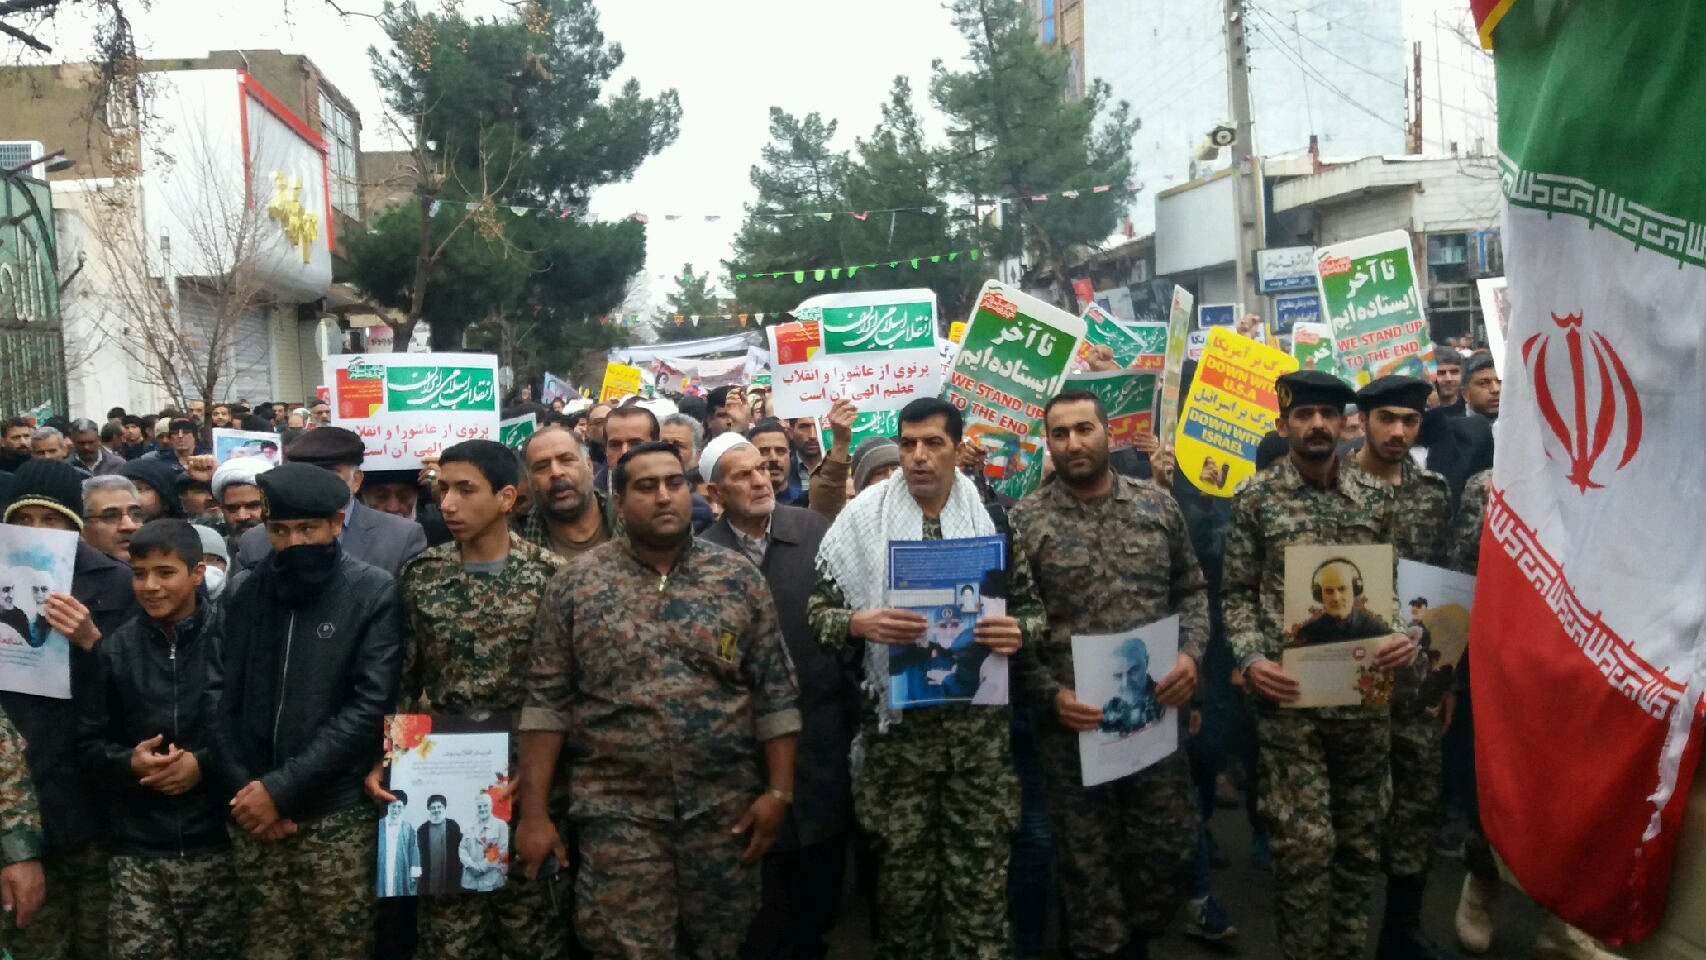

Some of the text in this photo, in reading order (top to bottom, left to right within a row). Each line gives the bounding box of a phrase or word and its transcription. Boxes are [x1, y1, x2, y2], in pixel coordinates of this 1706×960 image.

[1346, 259, 1377, 299] آخر
[1381, 259, 1395, 280] تا
[990, 321, 1043, 348] آخر
[1037, 332, 1057, 357] تا
[1337, 337, 1359, 352] WE
[1361, 326, 1402, 346] STAND
[1405, 321, 1423, 334] UP
[1213, 335, 1252, 360] آمریکا
[1346, 355, 1364, 368] TO
[1367, 348, 1391, 364] THE
[783, 369, 819, 386] انقلاب
[824, 372, 830, 384] و
[834, 365, 874, 382] عاشورا
[878, 363, 890, 380] از
[894, 362, 929, 379] پرتوی
[1206, 356, 1249, 383] DOWN
[1249, 374, 1278, 396] WIT
[800, 382, 914, 402] عظیم الهی آن است
[951, 371, 1045, 420] WE STAND UP
[949, 392, 1028, 435] TO THE END
[353, 425, 381, 438] انقلا
[385, 429, 392, 440] و
[395, 424, 437, 440] عاشورا
[442, 423, 452, 438] از
[1188, 409, 1261, 447] DOWN WIT
[391, 441, 408, 459] آن
[413, 442, 443, 458] الهی
[1201, 427, 1244, 456] ISRAEL
